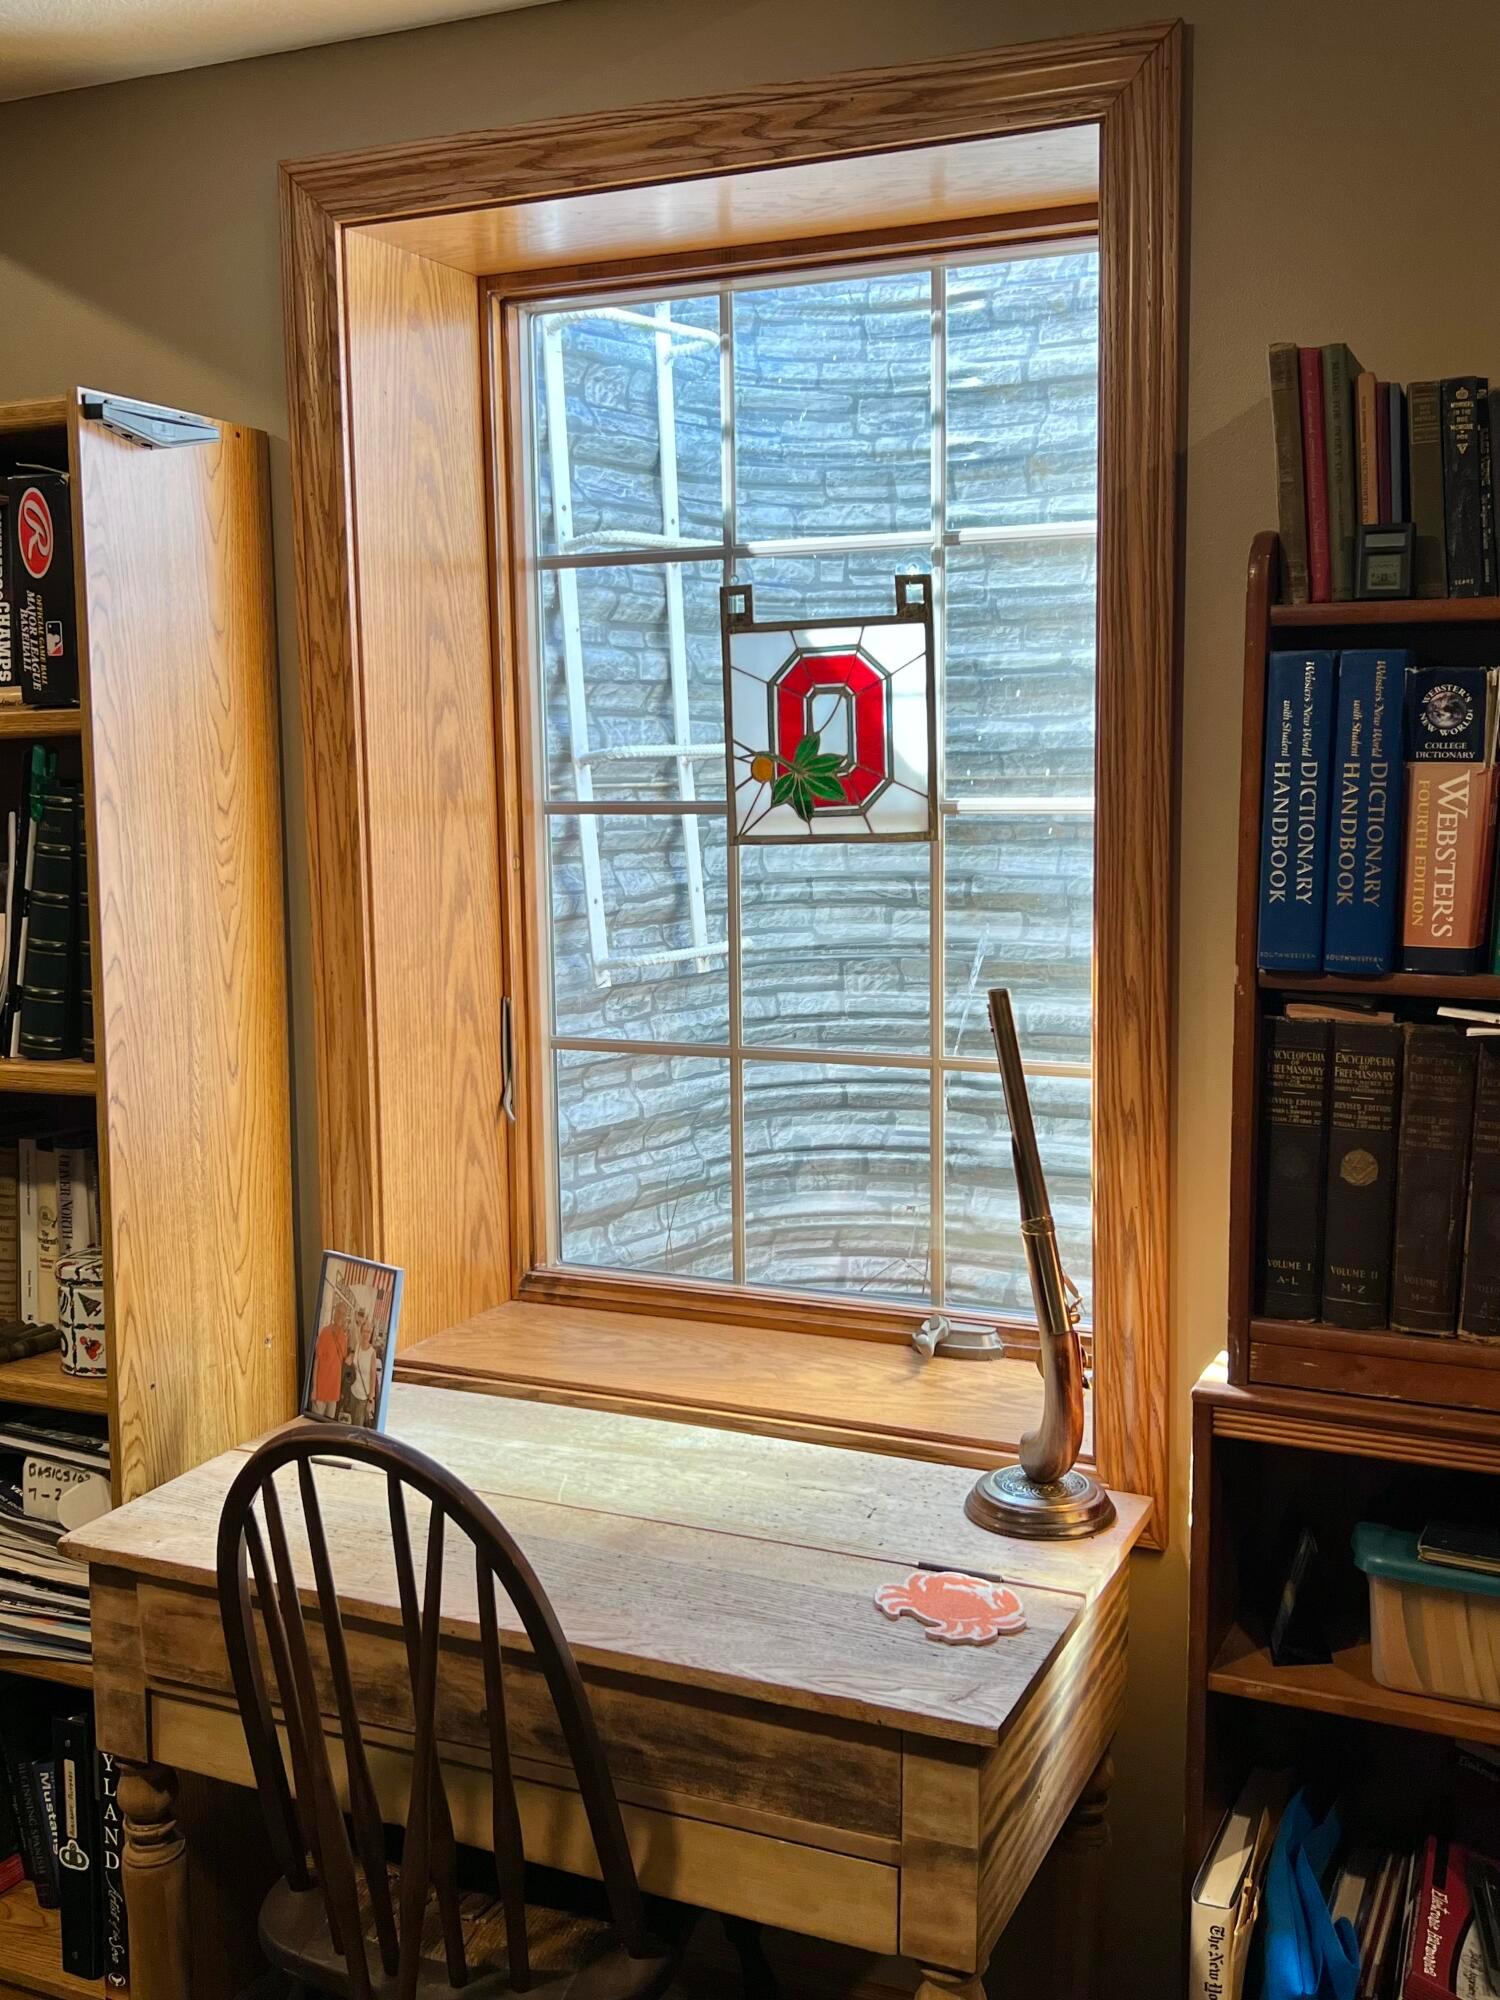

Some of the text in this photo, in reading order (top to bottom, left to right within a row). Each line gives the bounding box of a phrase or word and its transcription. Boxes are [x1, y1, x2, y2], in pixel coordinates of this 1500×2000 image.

[36, 594, 44, 634] OFFICIAL
[0, 601, 12, 682] CHAMPS
[20, 608, 32, 672] BASEBALL
[26, 590, 42, 691] MAJOR LEAGUE
[39, 637, 47, 662] GAME
[1422, 684, 1473, 704] WEBSTER'S
[1419, 711, 1474, 737] NEW WORLD
[1415, 751, 1475, 759] DICTIONARY
[1295, 661, 1319, 904] Webster's New World DICTIONARY
[1363, 661, 1389, 907] Webster's New World DICTIONARY
[1268, 700, 1293, 904] with Student HANDBOOK
[1336, 700, 1363, 905] with Student HANDBOOK
[1411, 780, 1430, 927] FOURTH EDITION
[1431, 769, 1471, 938] WEBSTER'S
[1268, 1063, 1325, 1077] REEMASONRY
[1270, 1048, 1326, 1062] NCYCLOPÆDIA
[1335, 1066, 1395, 1081] FREEMASONRY
[60, 1154, 73, 1239] OLIVER NORTH
[1267, 1258, 1312, 1272] VOLUME I
[1331, 1265, 1366, 1280] VOLUME
[1276, 1275, 1299, 1286] A-L
[29, 1462, 70, 1482] BASICS
[30, 1831, 45, 1875] SPANISH
[1207, 1925, 1226, 1951] The
[1208, 1951, 1224, 1981] New
